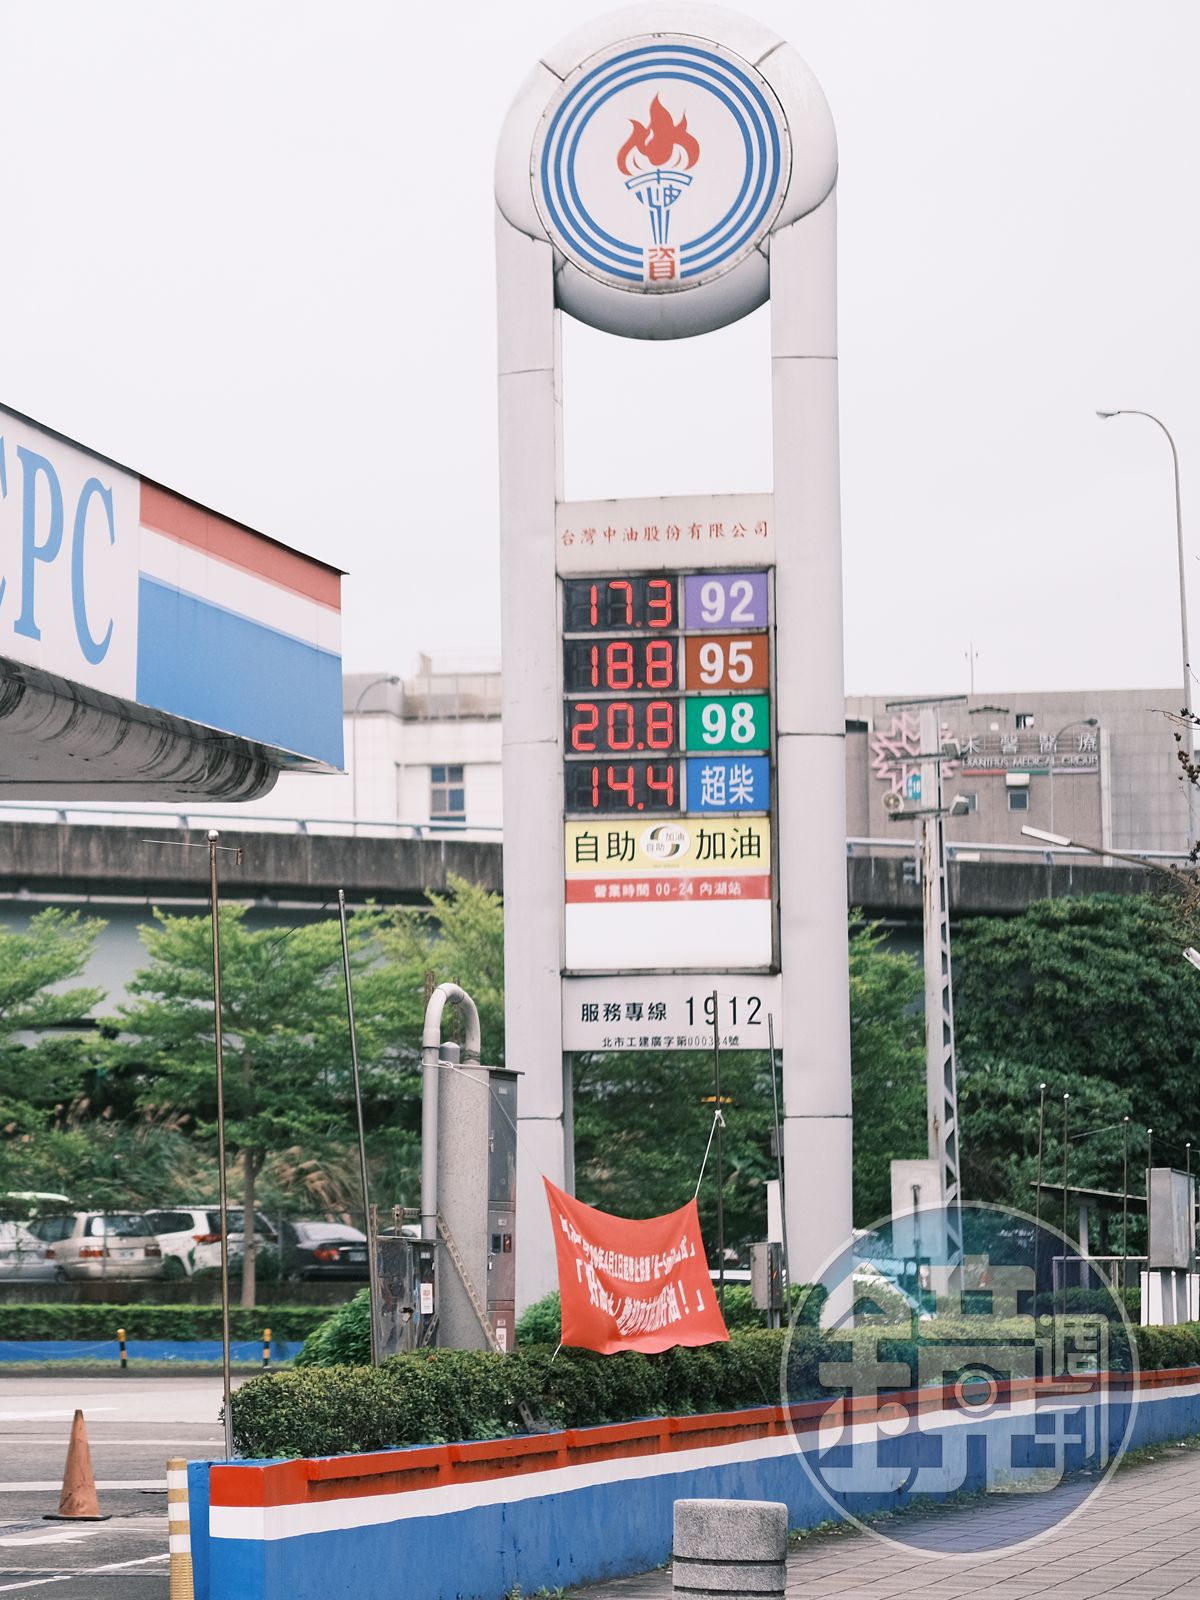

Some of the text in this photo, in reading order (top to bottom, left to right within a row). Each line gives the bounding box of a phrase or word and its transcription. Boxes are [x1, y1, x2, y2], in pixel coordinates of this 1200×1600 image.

[561, 520, 769, 546] 台灣中油股份有限公司
[700, 580, 755, 623] 92
[590, 640, 673, 690] 18.8
[699, 641, 754, 684] 95
[571, 701, 674, 751] 20.8
[701, 702, 756, 745] 98
[591, 765, 674, 811] 14.4
[701, 764, 754, 806] 超柴
[575, 827, 761, 863] 自助 加油
[594, 880, 741, 898] 營業時間 00-24 內湖站
[581, 996, 762, 1026] 服務專線 1912
